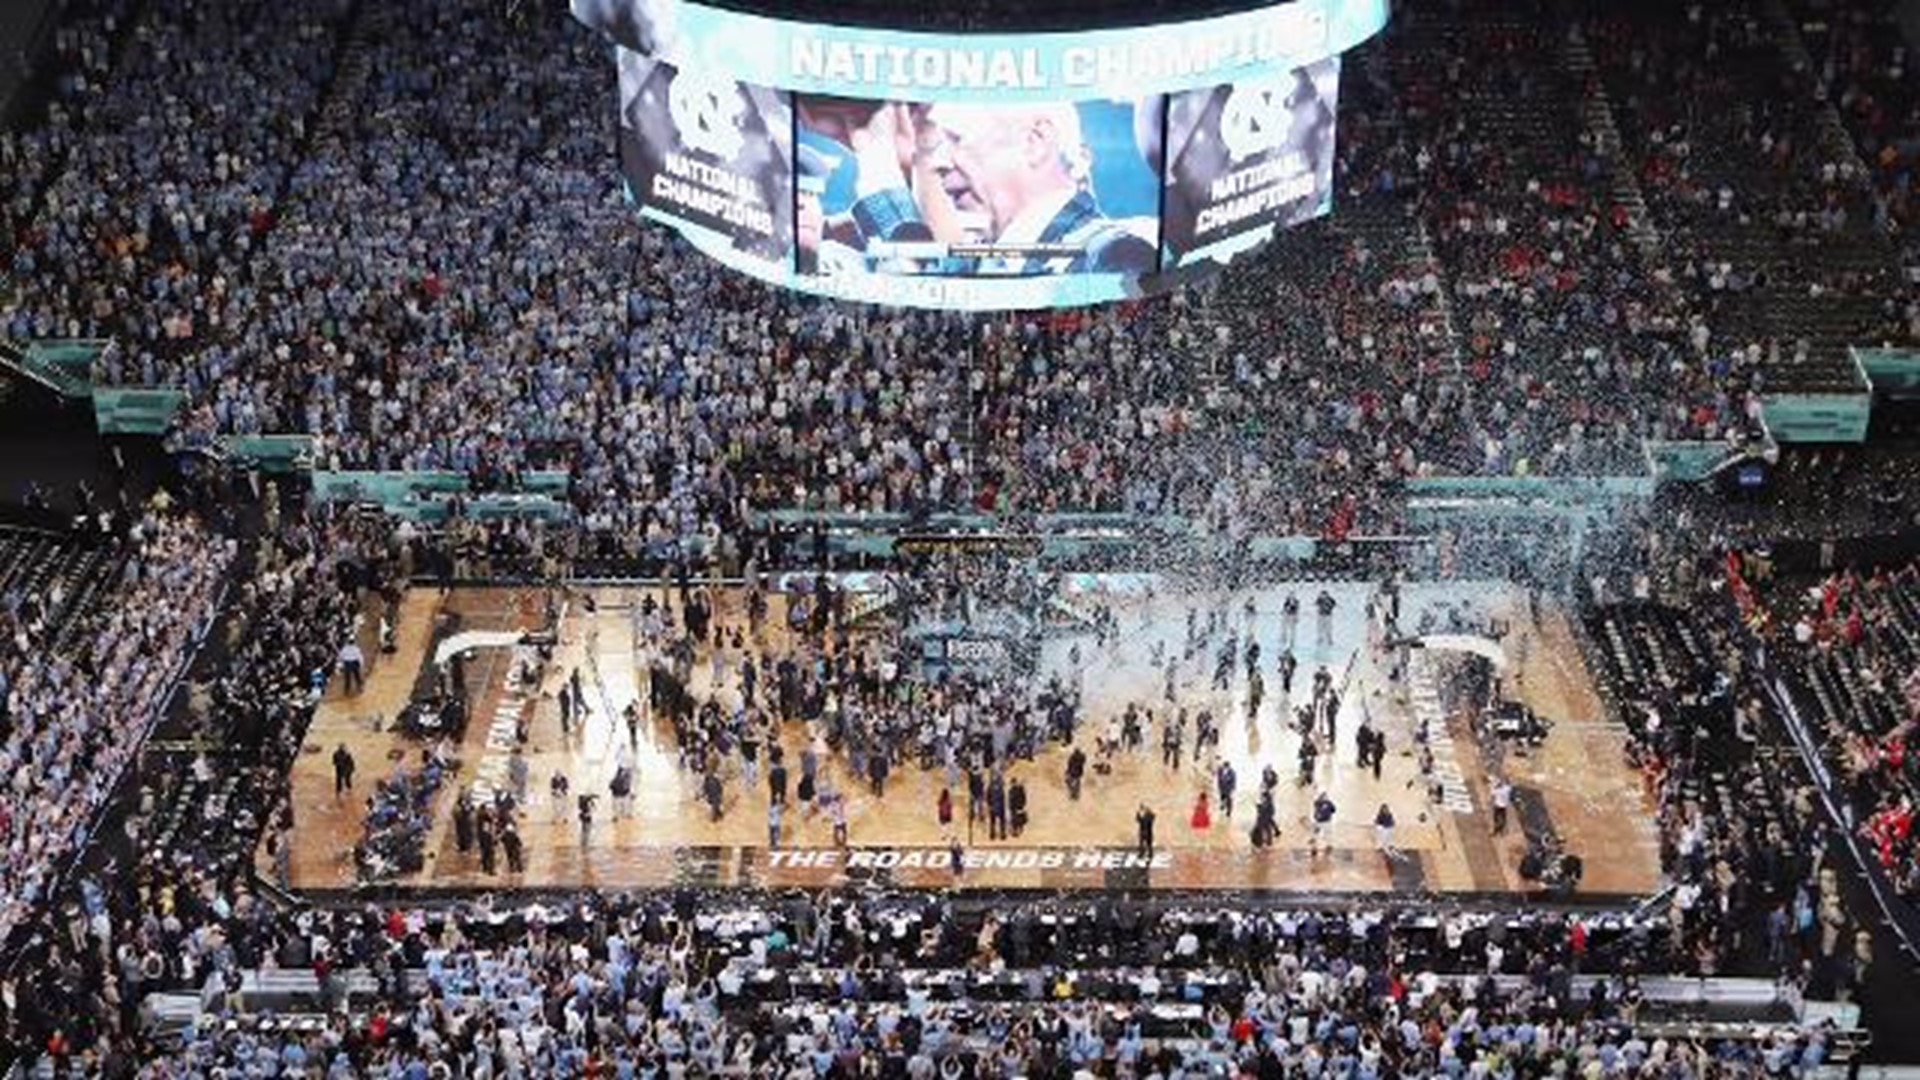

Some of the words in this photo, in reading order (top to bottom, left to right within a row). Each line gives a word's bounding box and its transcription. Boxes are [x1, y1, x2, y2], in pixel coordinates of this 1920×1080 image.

[791, 38, 1048, 89] NATIONAL
[1062, 11, 1327, 86] CHAMPIOS
[652, 173, 775, 235] CHAMPIONS
[664, 154, 762, 204] NATIONAL
[1195, 172, 1315, 233] CHAMPIONS
[1211, 154, 1301, 202] NATIONAL
[767, 851, 840, 869] THE
[848, 851, 953, 869] ROAD
[960, 851, 1066, 869] ENDS
